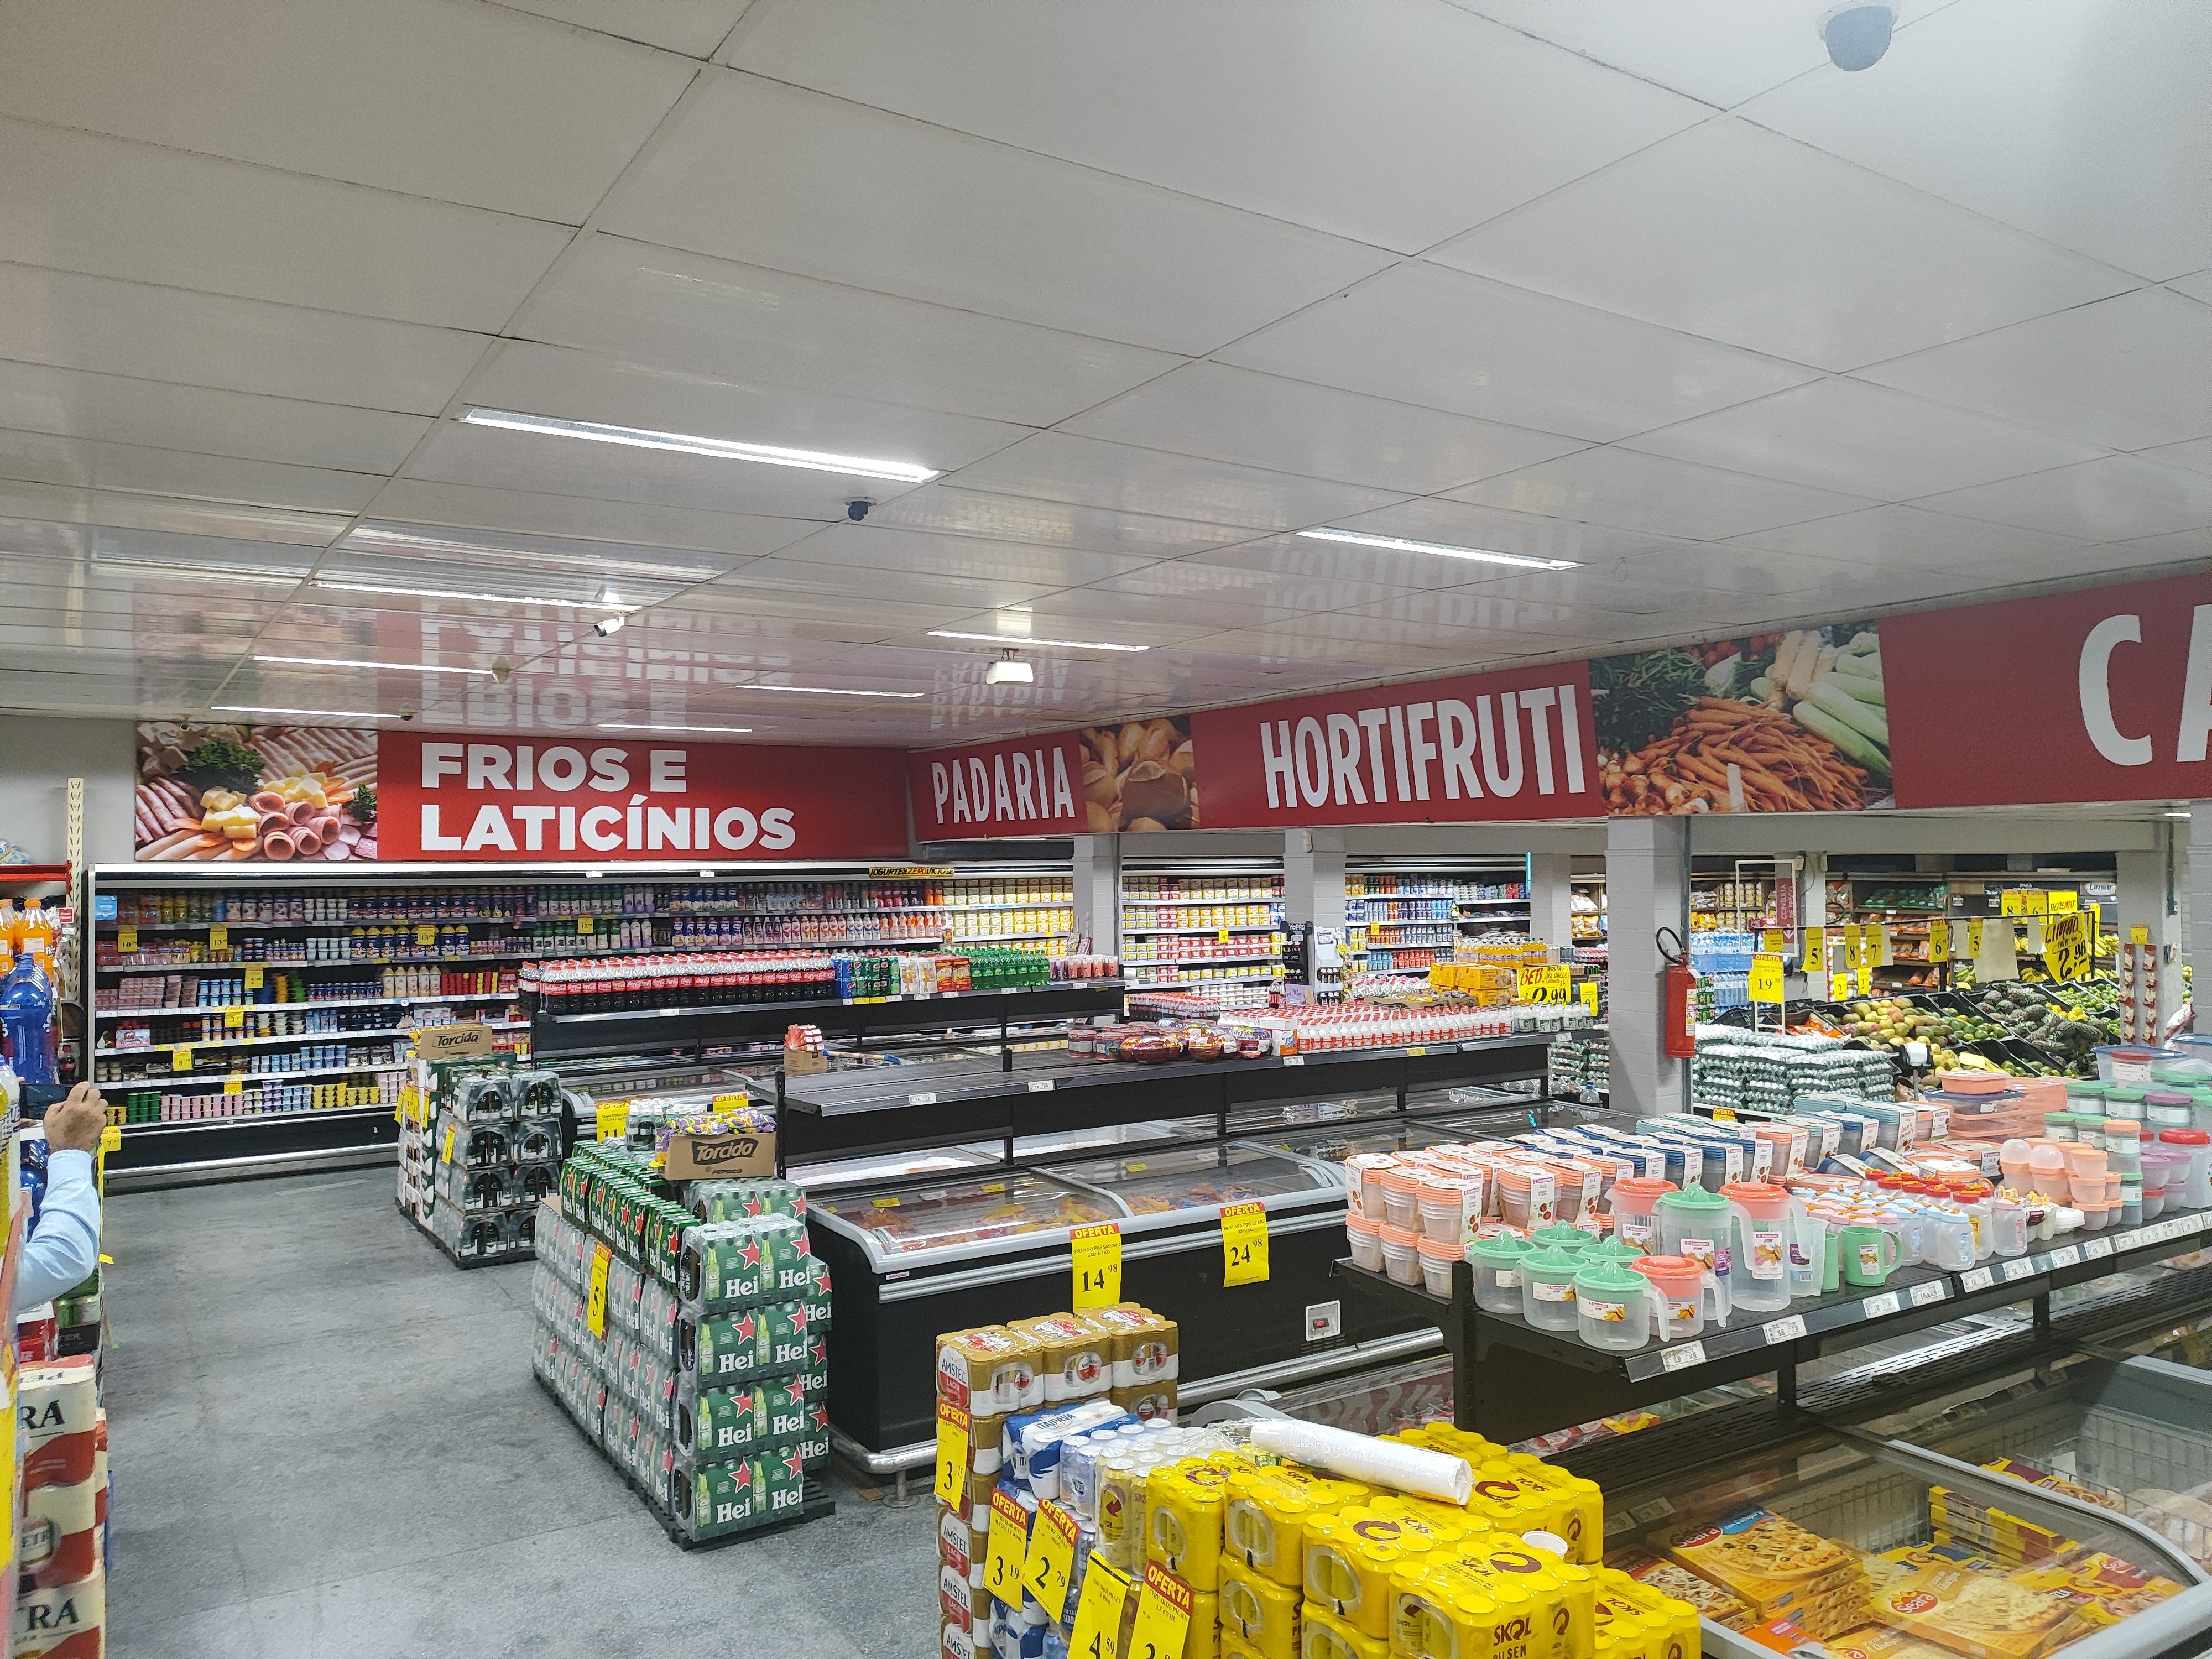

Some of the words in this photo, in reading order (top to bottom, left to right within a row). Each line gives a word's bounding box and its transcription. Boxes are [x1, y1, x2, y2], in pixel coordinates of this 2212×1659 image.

[1260, 684, 1585, 808] HORTIFRUTI
[421, 742, 629, 792] FRIOS
[650, 750, 687, 792] E
[931, 747, 1076, 824] PADARIA
[421, 794, 796, 851] LATICÍNIOS
[1811, 947, 1819, 964] 5
[1849, 947, 1855, 962] 8
[1871, 944, 1877, 961] 7
[1935, 940, 1942, 955] 6
[1974, 936, 1979, 951] 5
[2058, 947, 2072, 980] 2
[1758, 978, 1772, 990] 19
[437, 1032, 479, 1047] Torcida
[715, 1093, 745, 1102] OFERTA
[696, 1140, 754, 1162] Torcida
[1224, 1203, 1261, 1217] OFERTA
[615, 1229, 627, 1251] Hei
[1074, 1225, 1115, 1239] OFERTA
[1230, 1244, 1251, 1266] 24
[1253, 1239, 1262, 1248] 98
[661, 1259, 677, 1284] Hei
[779, 1266, 811, 1289] Hei
[1081, 1269, 1105, 1292] 14
[1108, 1264, 1118, 1273] 98
[725, 1275, 759, 1298] Hei
[592, 1285, 599, 1317] 5
[806, 1301, 832, 1322] Hei
[719, 1349, 755, 1374] Hei
[775, 1340, 808, 1364] Hei
[801, 1370, 828, 1391] Hei
[942, 1359, 966, 1384] AMSTEL
[773, 1410, 805, 1436] Hei
[940, 1403, 969, 1426] OFERTA
[1035, 1413, 1076, 1430] ITAIPAVA
[717, 1422, 753, 1448] Hei
[801, 1436, 830, 1460] Hei
[943, 1460, 953, 1490] 3
[1282, 1471, 1313, 1484] SKOL
[1515, 1477, 1550, 1493] SKOL
[772, 1484, 804, 1510] Hei
[993, 1492, 1026, 1526] OFERTA
[717, 1498, 751, 1524] Hei
[1042, 1499, 1077, 1543] OFERTA
[943, 1525, 967, 1554] AMSTEL
[1674, 1527, 1720, 1547] Seara
[993, 1556, 1004, 1586] 3
[1010, 1564, 1019, 1579] 19
[1035, 1556, 1050, 1590] 2
[1056, 1570, 1066, 1588] 79
[1456, 1559, 1494, 1578] SKOL
[943, 1577, 968, 1609] AMSTEL
[1148, 1566, 1191, 1610] OFERTA
[1604, 1597, 1647, 1616] SKOL
[1898, 1594, 1935, 1613] Seara
[1494, 1616, 1532, 1647] SKOL
[1089, 1631, 1101, 1659] 4
[1106, 1636, 1115, 1655] 59
